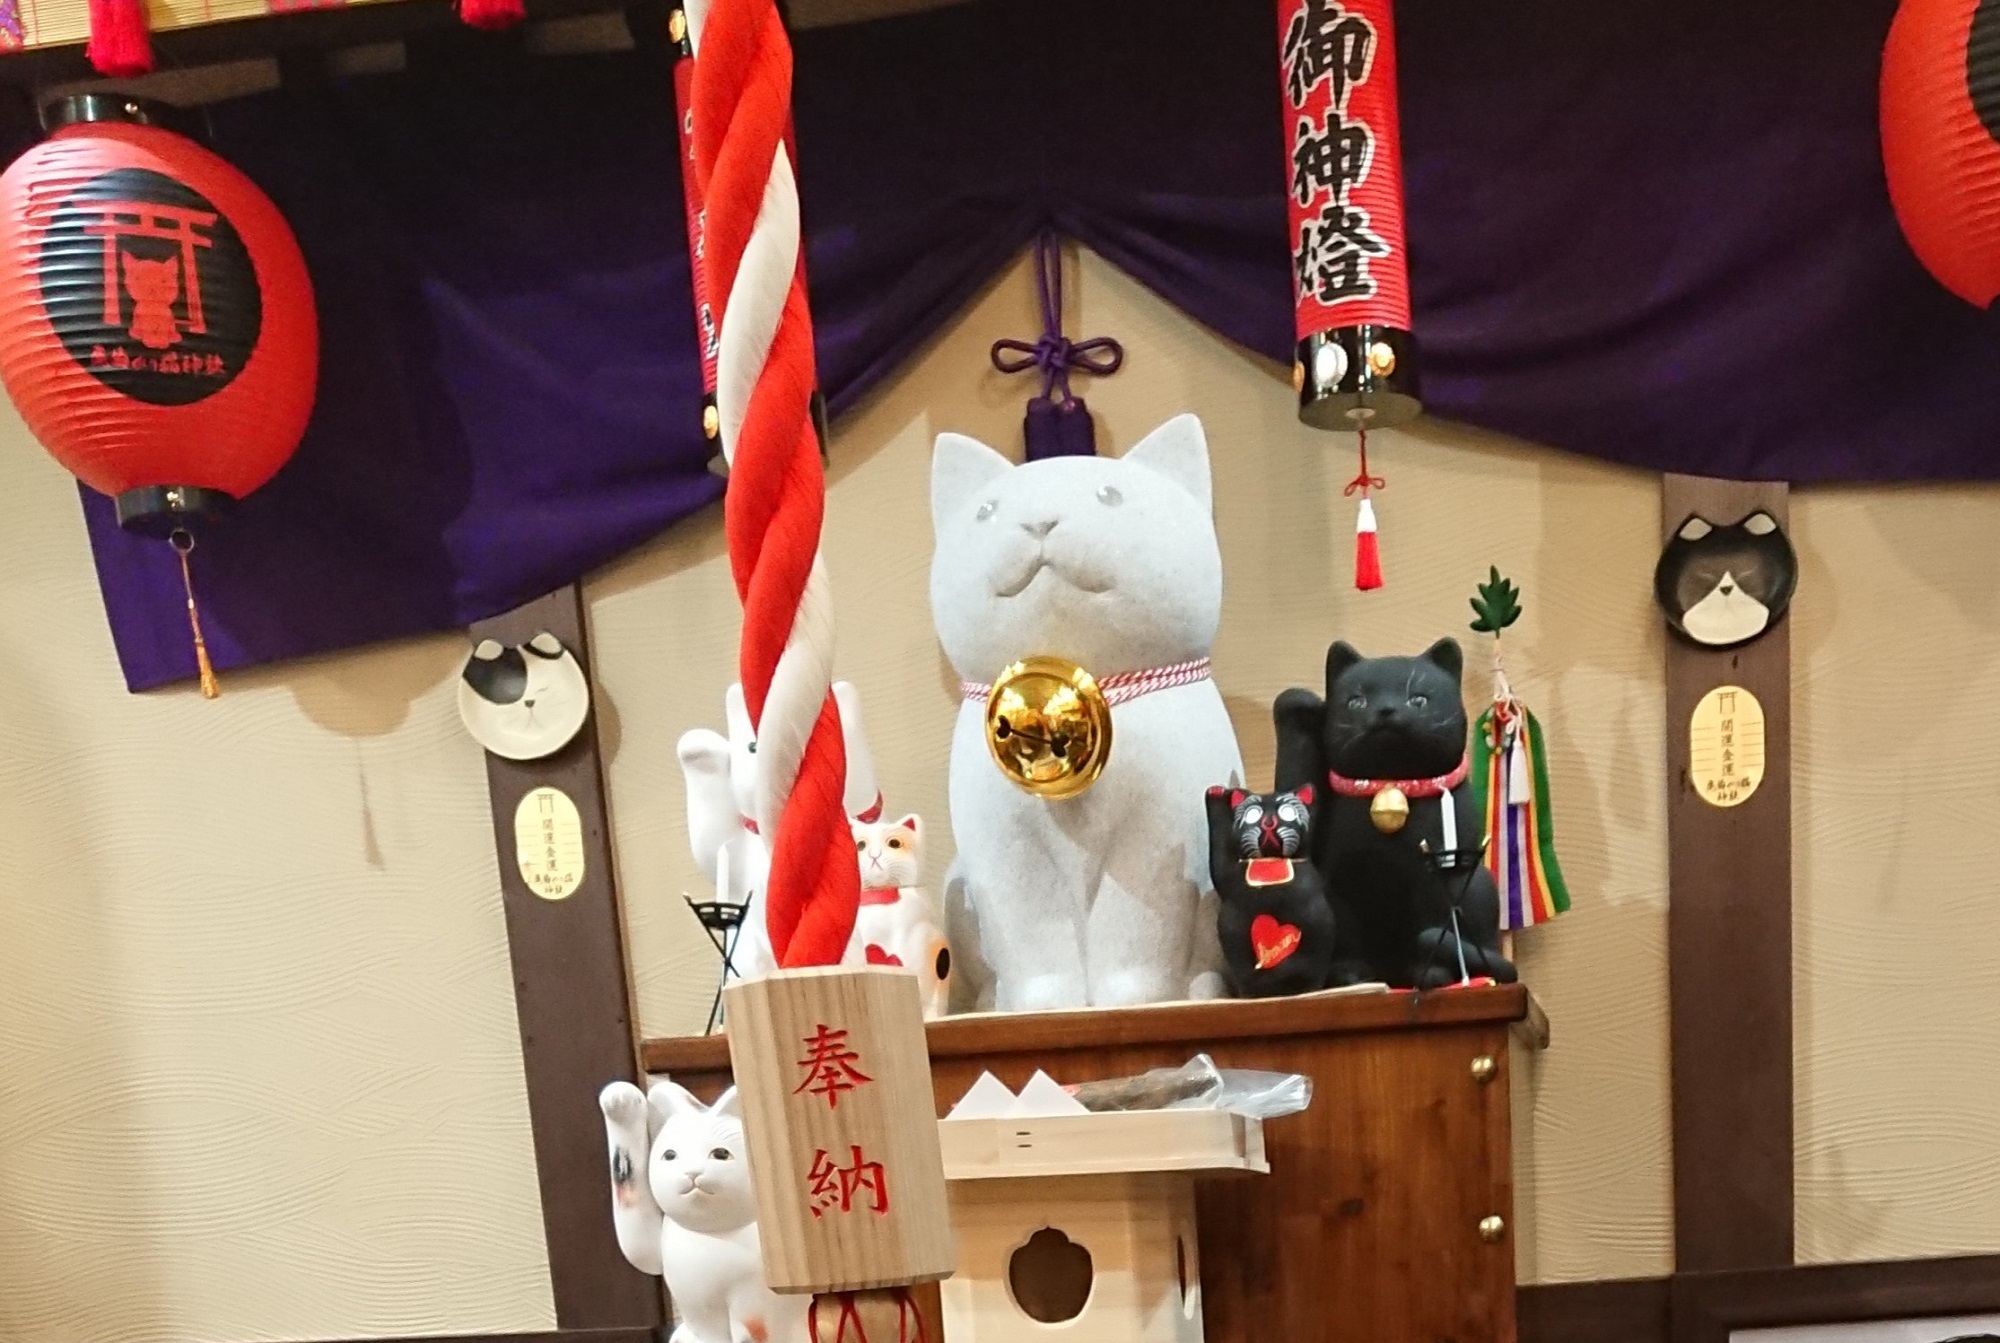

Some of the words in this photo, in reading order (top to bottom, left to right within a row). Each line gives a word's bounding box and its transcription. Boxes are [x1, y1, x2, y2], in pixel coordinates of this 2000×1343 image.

[1284, 0, 1391, 304] 御神燈
[792, 1023, 890, 1220] 奉納
